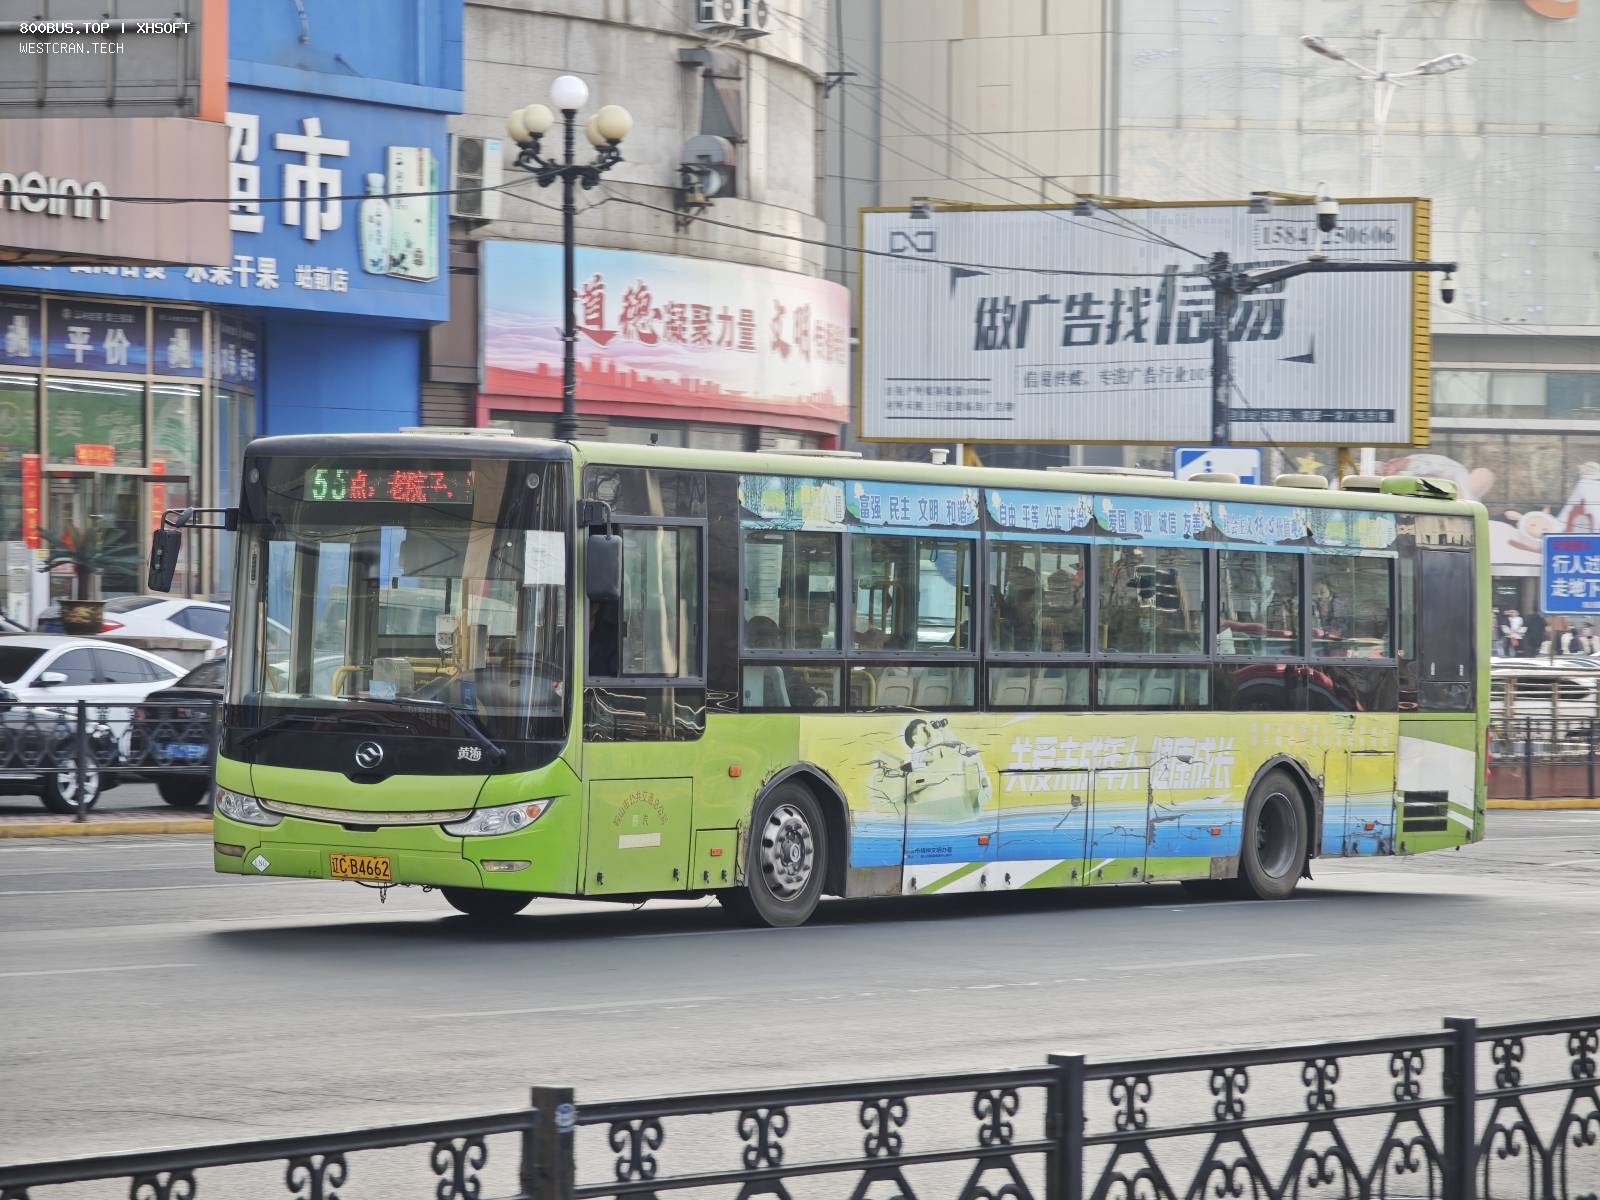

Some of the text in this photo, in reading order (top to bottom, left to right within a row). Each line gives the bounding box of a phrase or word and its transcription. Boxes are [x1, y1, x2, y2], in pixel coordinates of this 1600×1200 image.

[311, 468, 348, 501] 55
[859, 494, 882, 520] 富强
[889, 496, 911, 522] 民主
[918, 497, 940, 523] 文明
[945, 498, 969, 525] 和谐
[999, 503, 1017, 528] 自由
[1022, 504, 1041, 529] 平等
[1045, 505, 1063, 530] 公正
[1108, 509, 1128, 533] 爱国
[1133, 510, 1153, 533] 敬业
[1158, 511, 1178, 535] 诚信
[457, 746, 482, 761] 黄海
